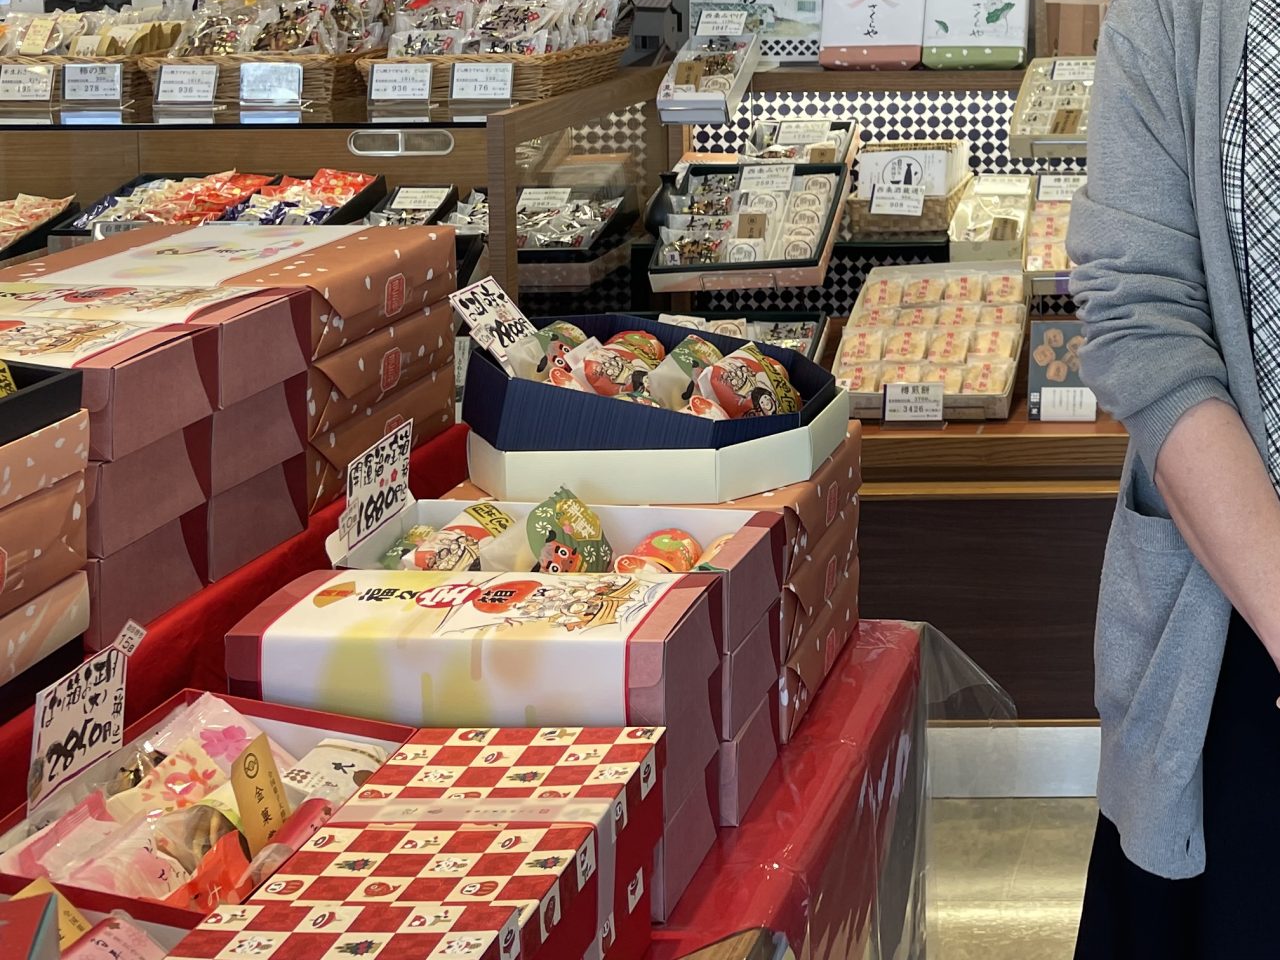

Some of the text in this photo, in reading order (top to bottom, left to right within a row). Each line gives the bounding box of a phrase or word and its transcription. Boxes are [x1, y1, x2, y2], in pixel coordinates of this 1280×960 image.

[901, 385, 930, 395] 樽煎餅
[903, 406, 924, 414] 3426
